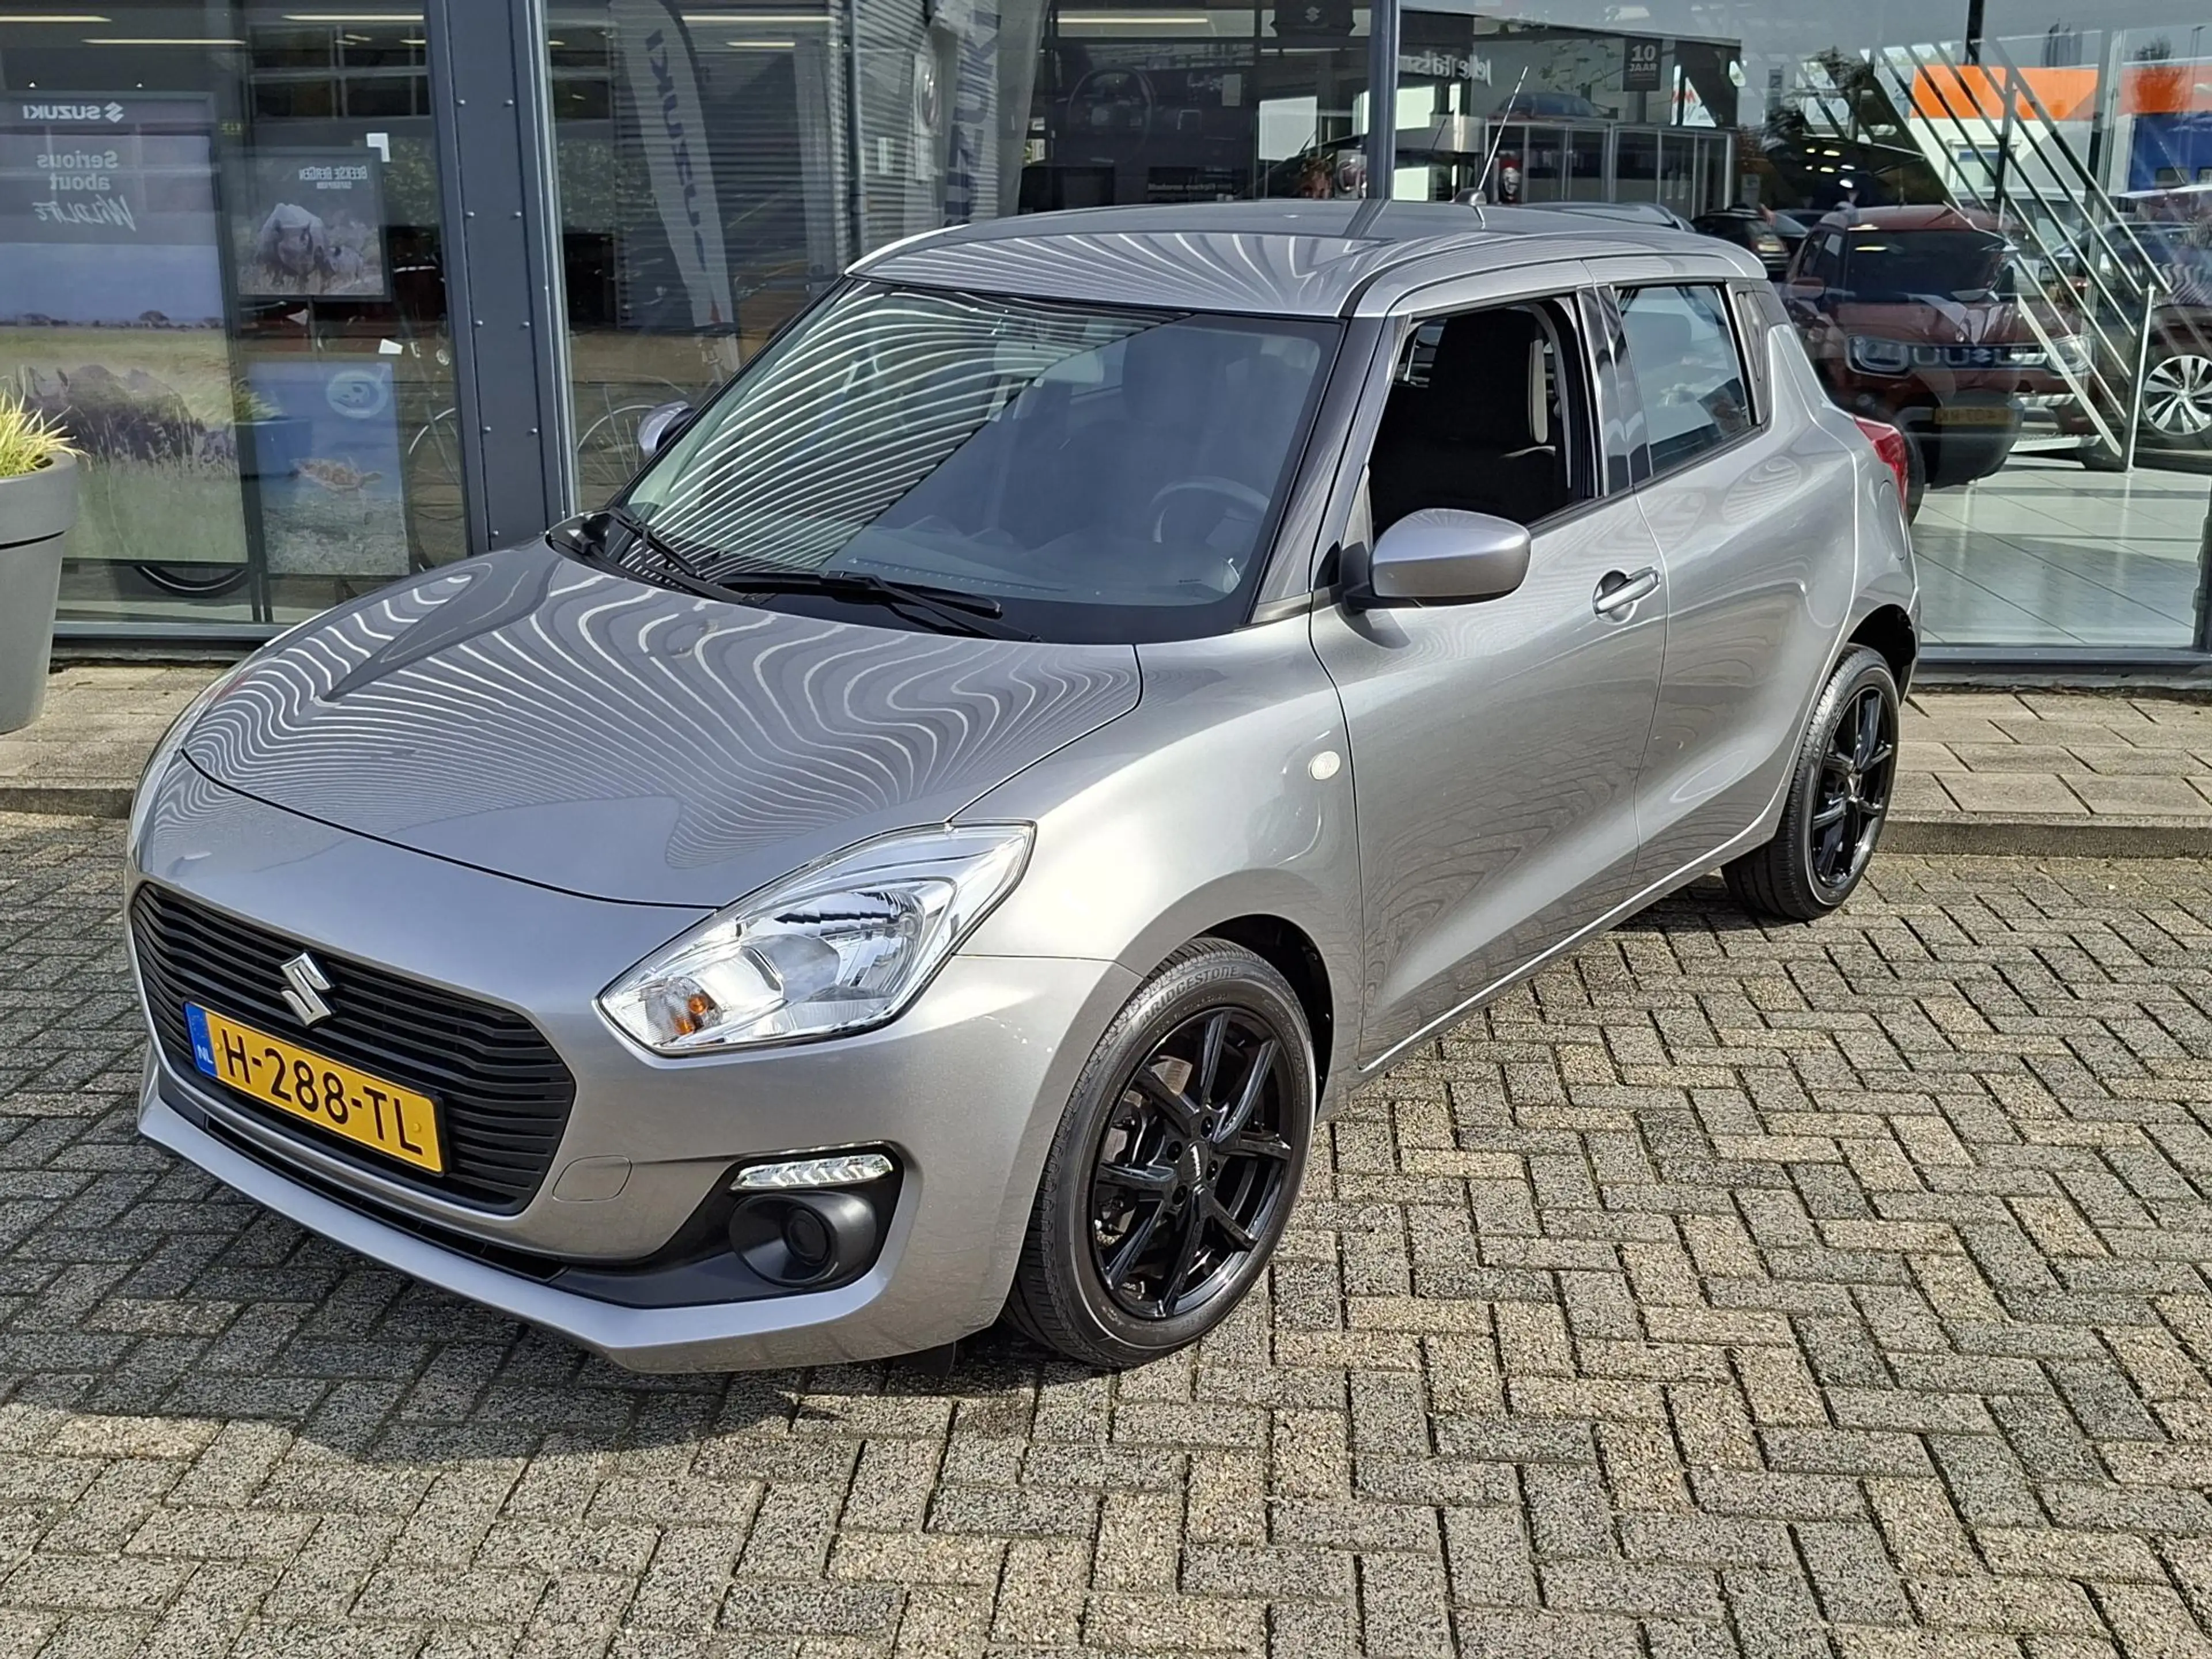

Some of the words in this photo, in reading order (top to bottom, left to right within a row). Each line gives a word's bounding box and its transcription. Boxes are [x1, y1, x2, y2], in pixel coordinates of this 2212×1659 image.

[1631, 44, 1656, 62] 10
[1628, 63, 1657, 72] JAAR
[196, 1044, 214, 1065] NL
[221, 1029, 423, 1156] H-288-TL
